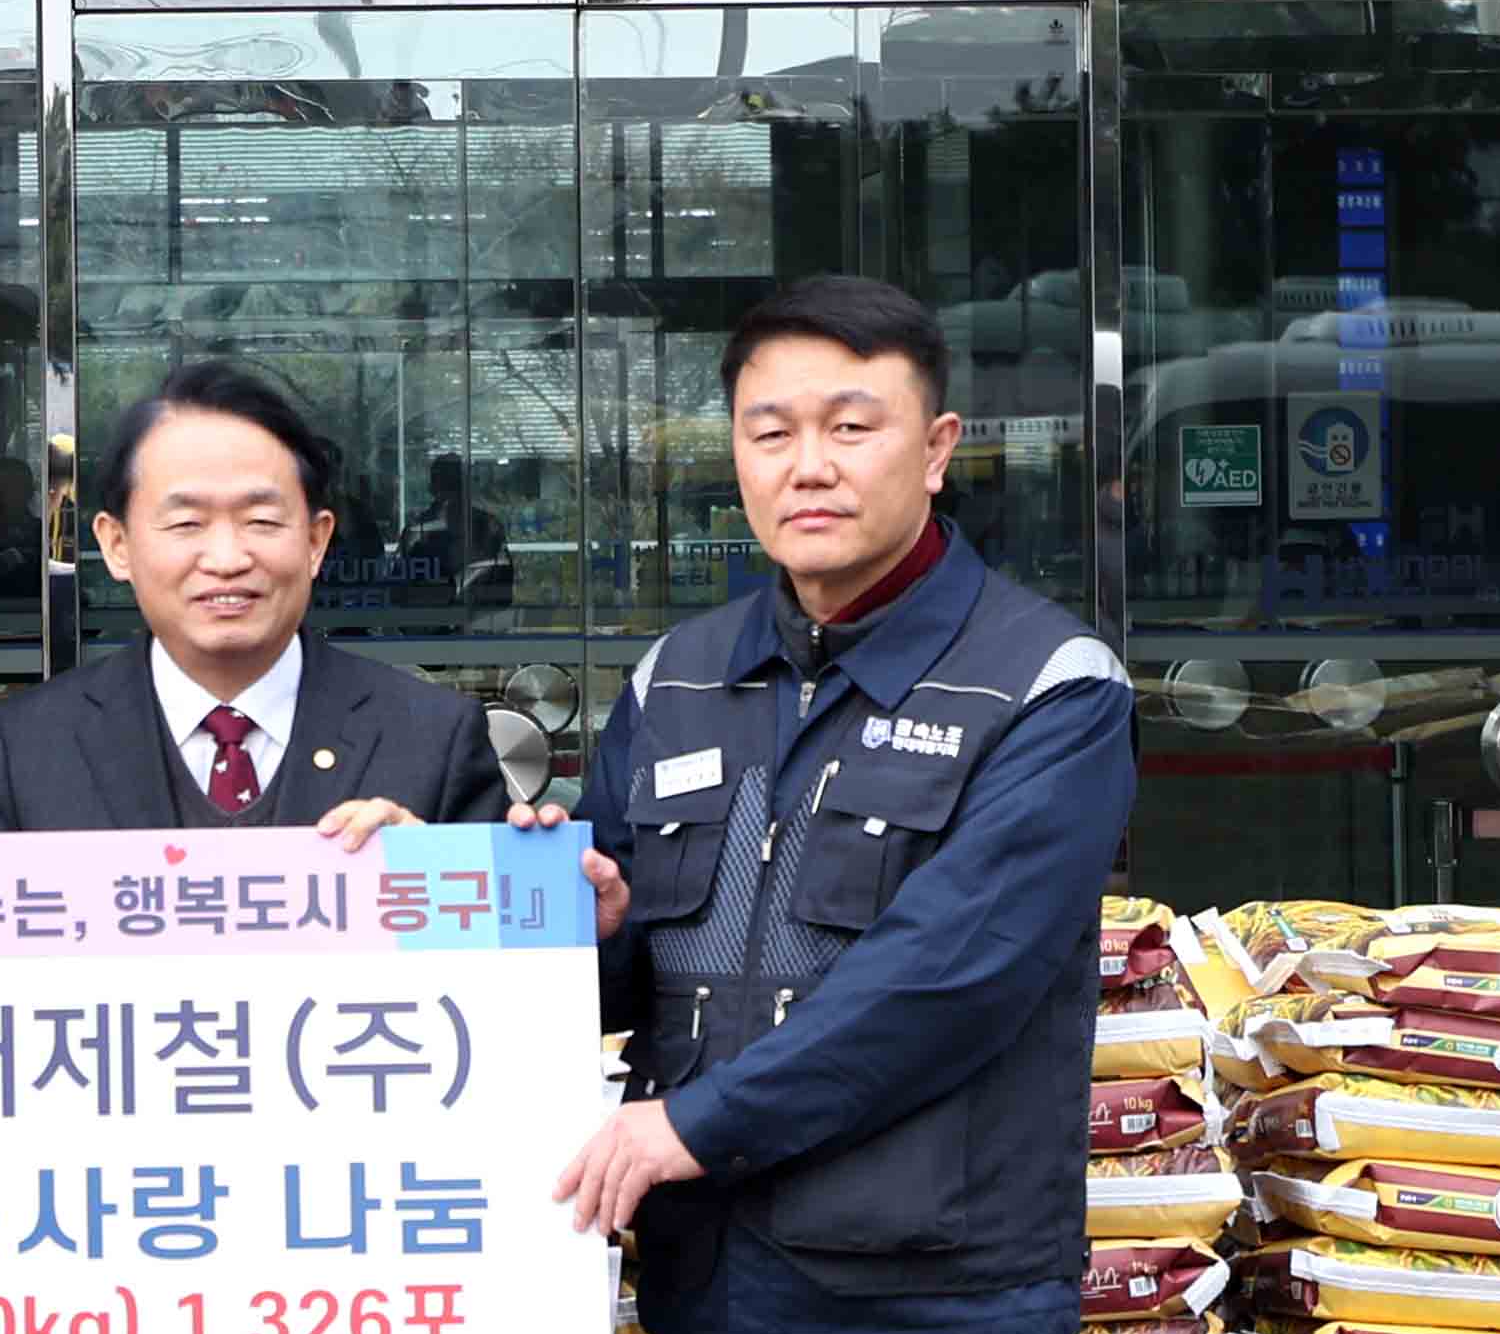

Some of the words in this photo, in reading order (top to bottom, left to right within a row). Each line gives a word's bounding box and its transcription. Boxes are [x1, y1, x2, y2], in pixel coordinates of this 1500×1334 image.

[1212, 470, 1257, 489] AED
[113, 872, 348, 936] 행복도시
[1122, 1096, 1154, 1113] 10kg
[284, 1159, 488, 1258] 나눔
